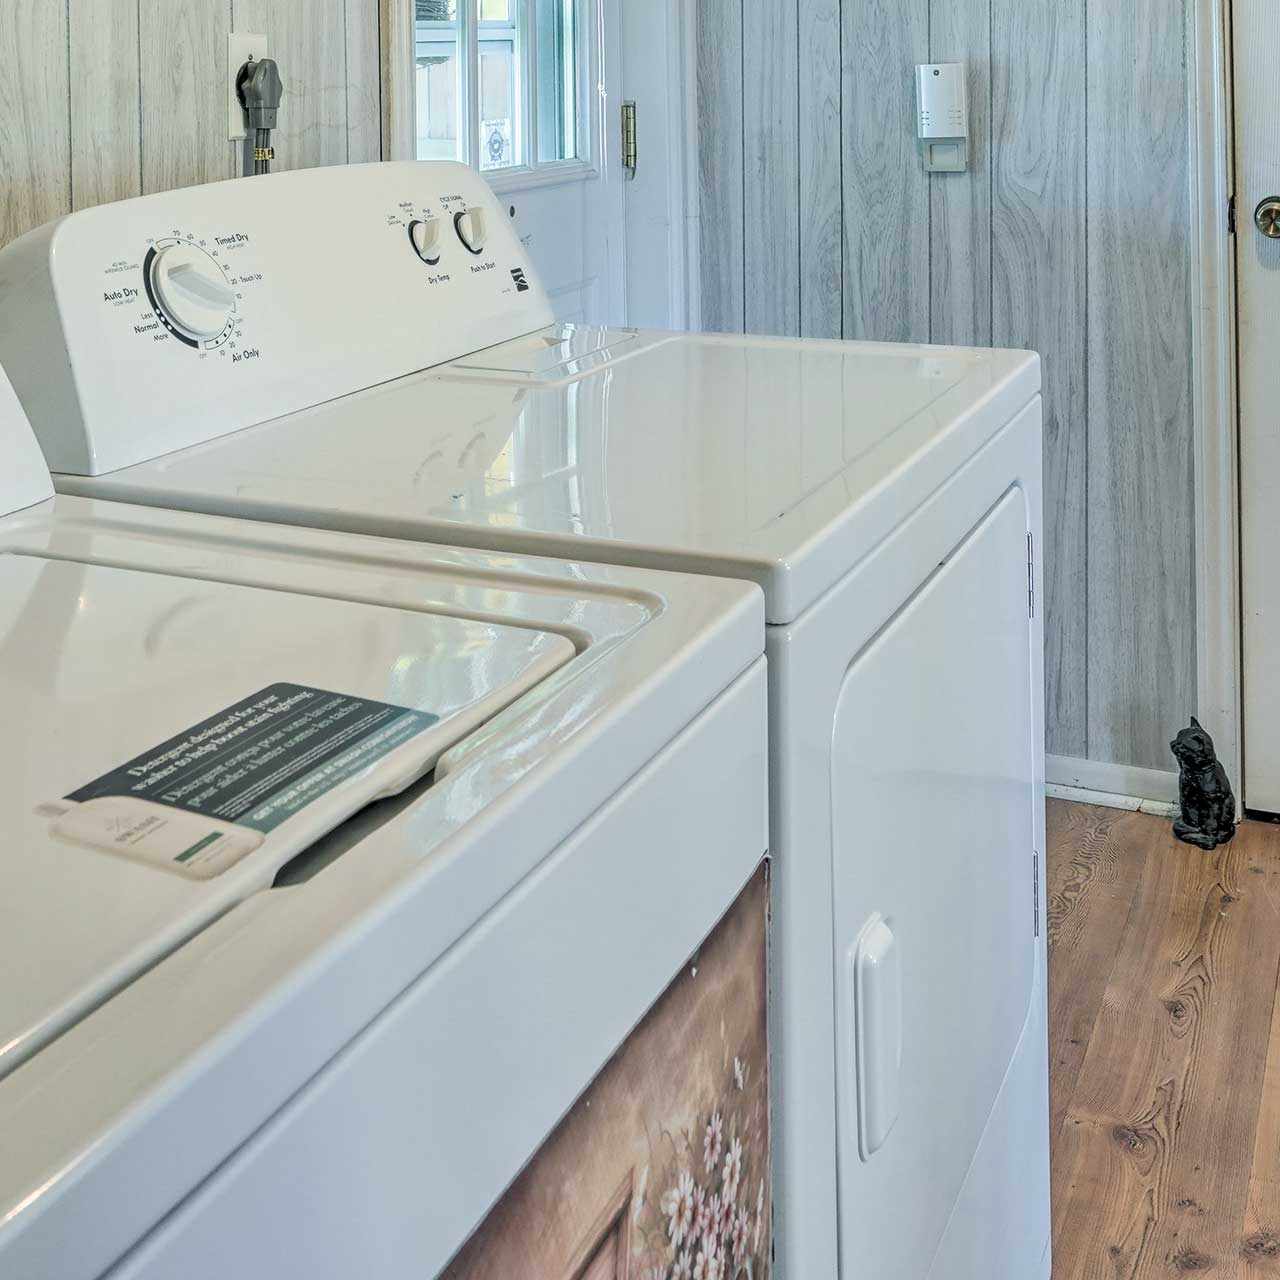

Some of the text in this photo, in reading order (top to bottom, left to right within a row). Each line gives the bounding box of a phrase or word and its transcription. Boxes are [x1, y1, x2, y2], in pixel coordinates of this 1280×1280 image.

[215, 232, 249, 246] Timed Dry
[470, 264, 481, 273] Push
[485, 261, 496, 270] Start
[240, 274, 253, 284] Touch
[254, 273, 263, 282] Up
[428, 273, 451, 285] Dry Temp
[103, 286, 139, 302] Auto Dry
[140, 312, 154, 320] Less
[133, 321, 160, 334] Normal
[153, 333, 169, 342] More
[228, 341, 236, 349] 20
[232, 348, 260, 362] Air Only
[128, 694, 279, 777] Detergent designed for your
[131, 764, 178, 791] washer
[175, 756, 193, 768] to
